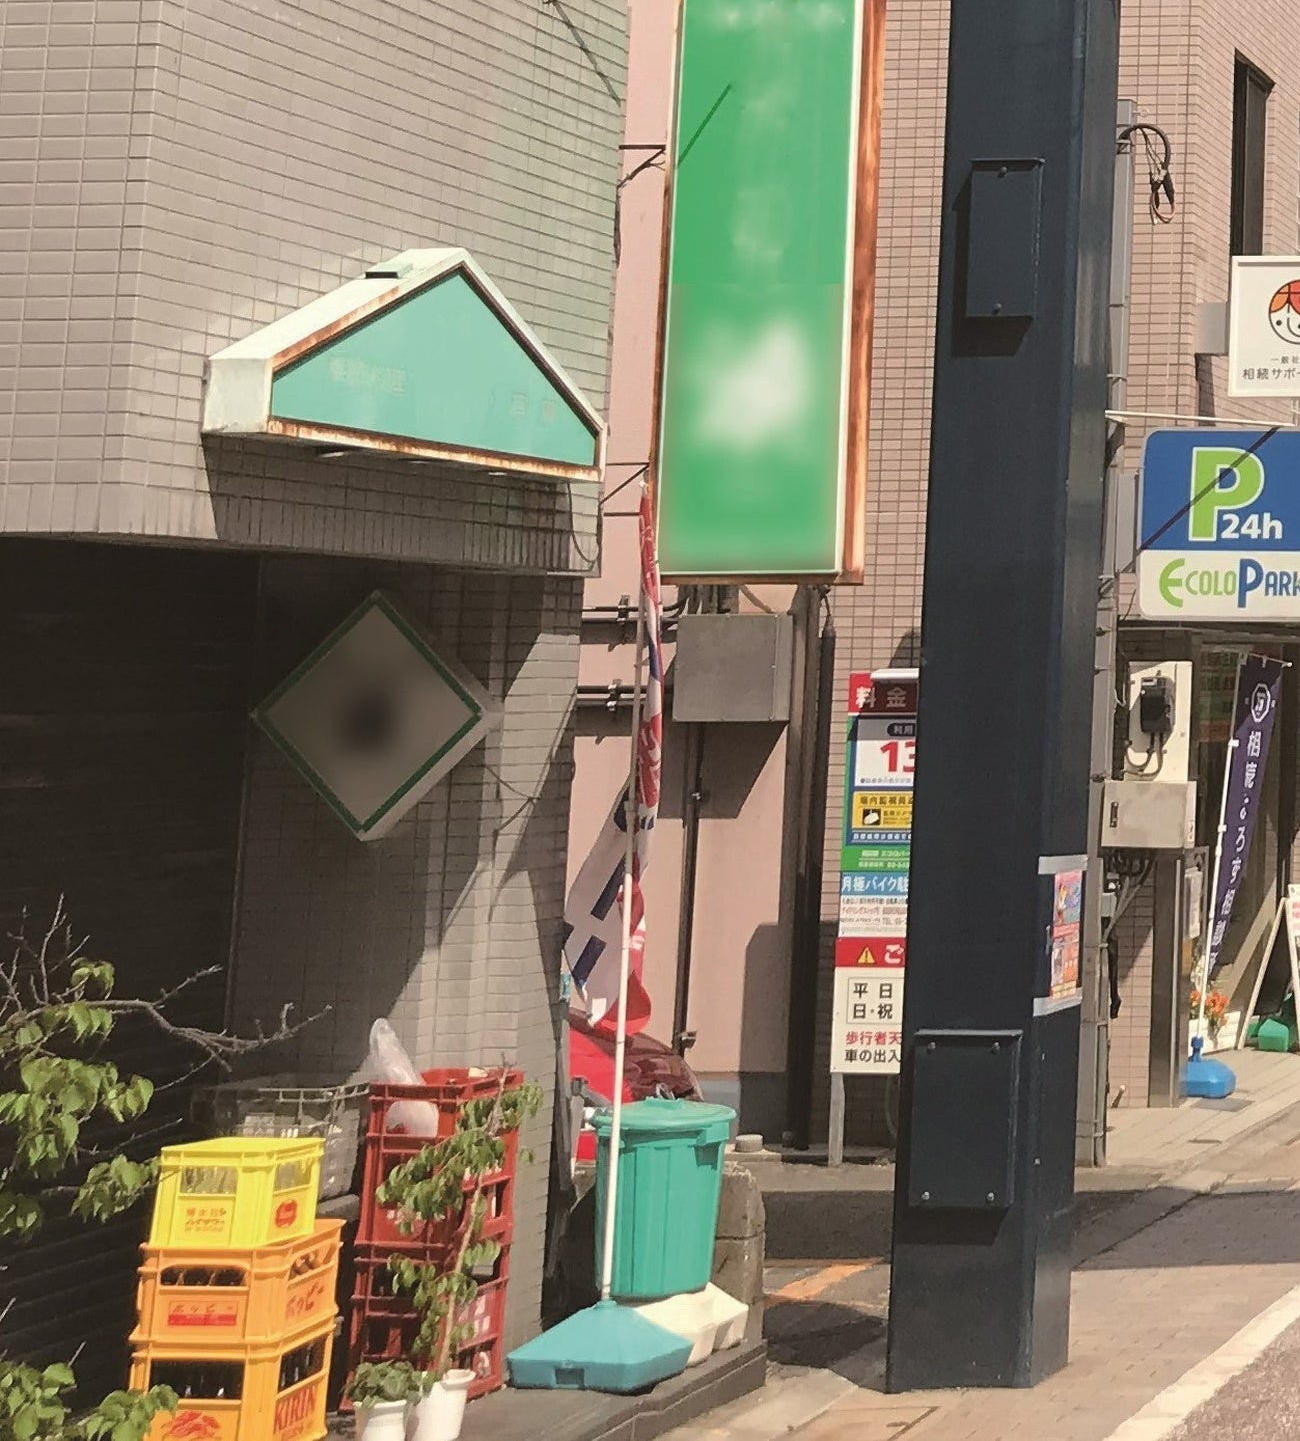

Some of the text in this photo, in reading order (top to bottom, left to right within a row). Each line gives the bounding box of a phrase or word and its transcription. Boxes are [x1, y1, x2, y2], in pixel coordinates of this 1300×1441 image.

[1188, 446, 1283, 542] P 24h
[855, 686, 907, 709] 料金
[853, 982, 893, 999] 平日
[275, 1386, 318, 1433] KIRIN
